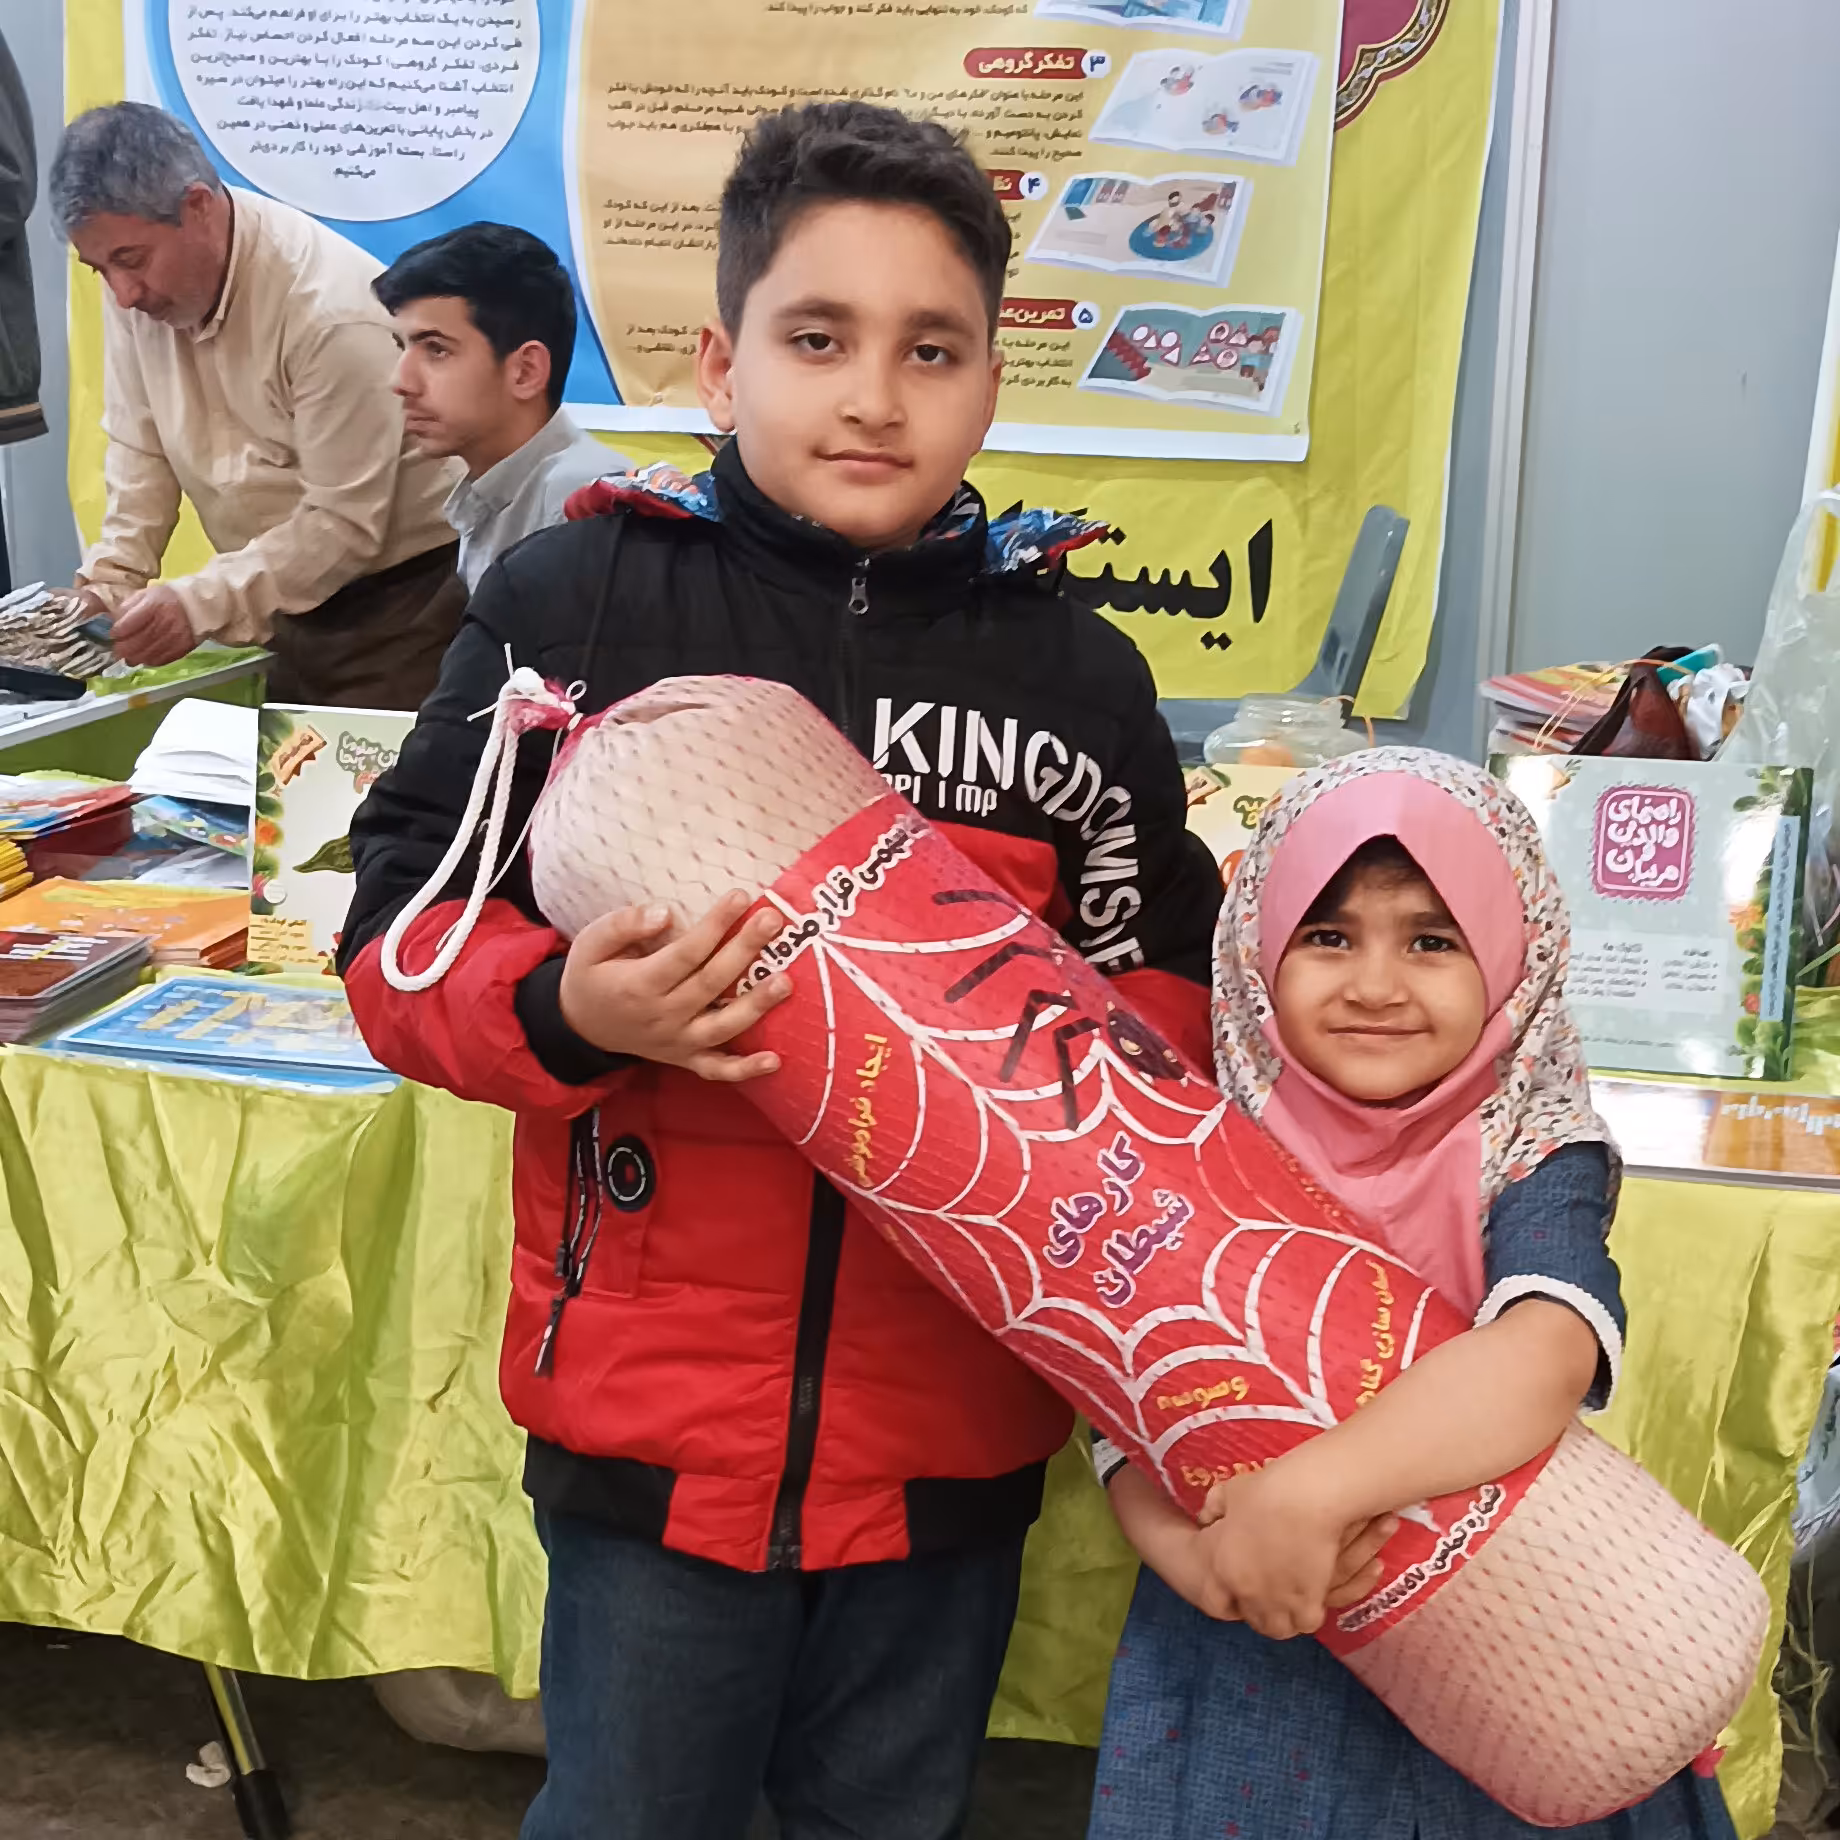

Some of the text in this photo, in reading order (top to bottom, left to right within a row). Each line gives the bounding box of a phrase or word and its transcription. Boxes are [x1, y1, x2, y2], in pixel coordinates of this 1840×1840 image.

[978, 50, 1106, 74] تفکر گروهی ۳
[1028, 178, 1040, 193] ۴
[1078, 308, 1093, 323] ۵
[1608, 796, 1681, 825] راهنمای
[1607, 820, 1679, 848] والدین
[1605, 848, 1679, 887] مربیان
[819, 871, 854, 925] قرار
[1043, 1131, 1145, 1268] کارهای
[1094, 1189, 1194, 1308] شیطان
[1467, 1486, 1501, 1529] شماره
